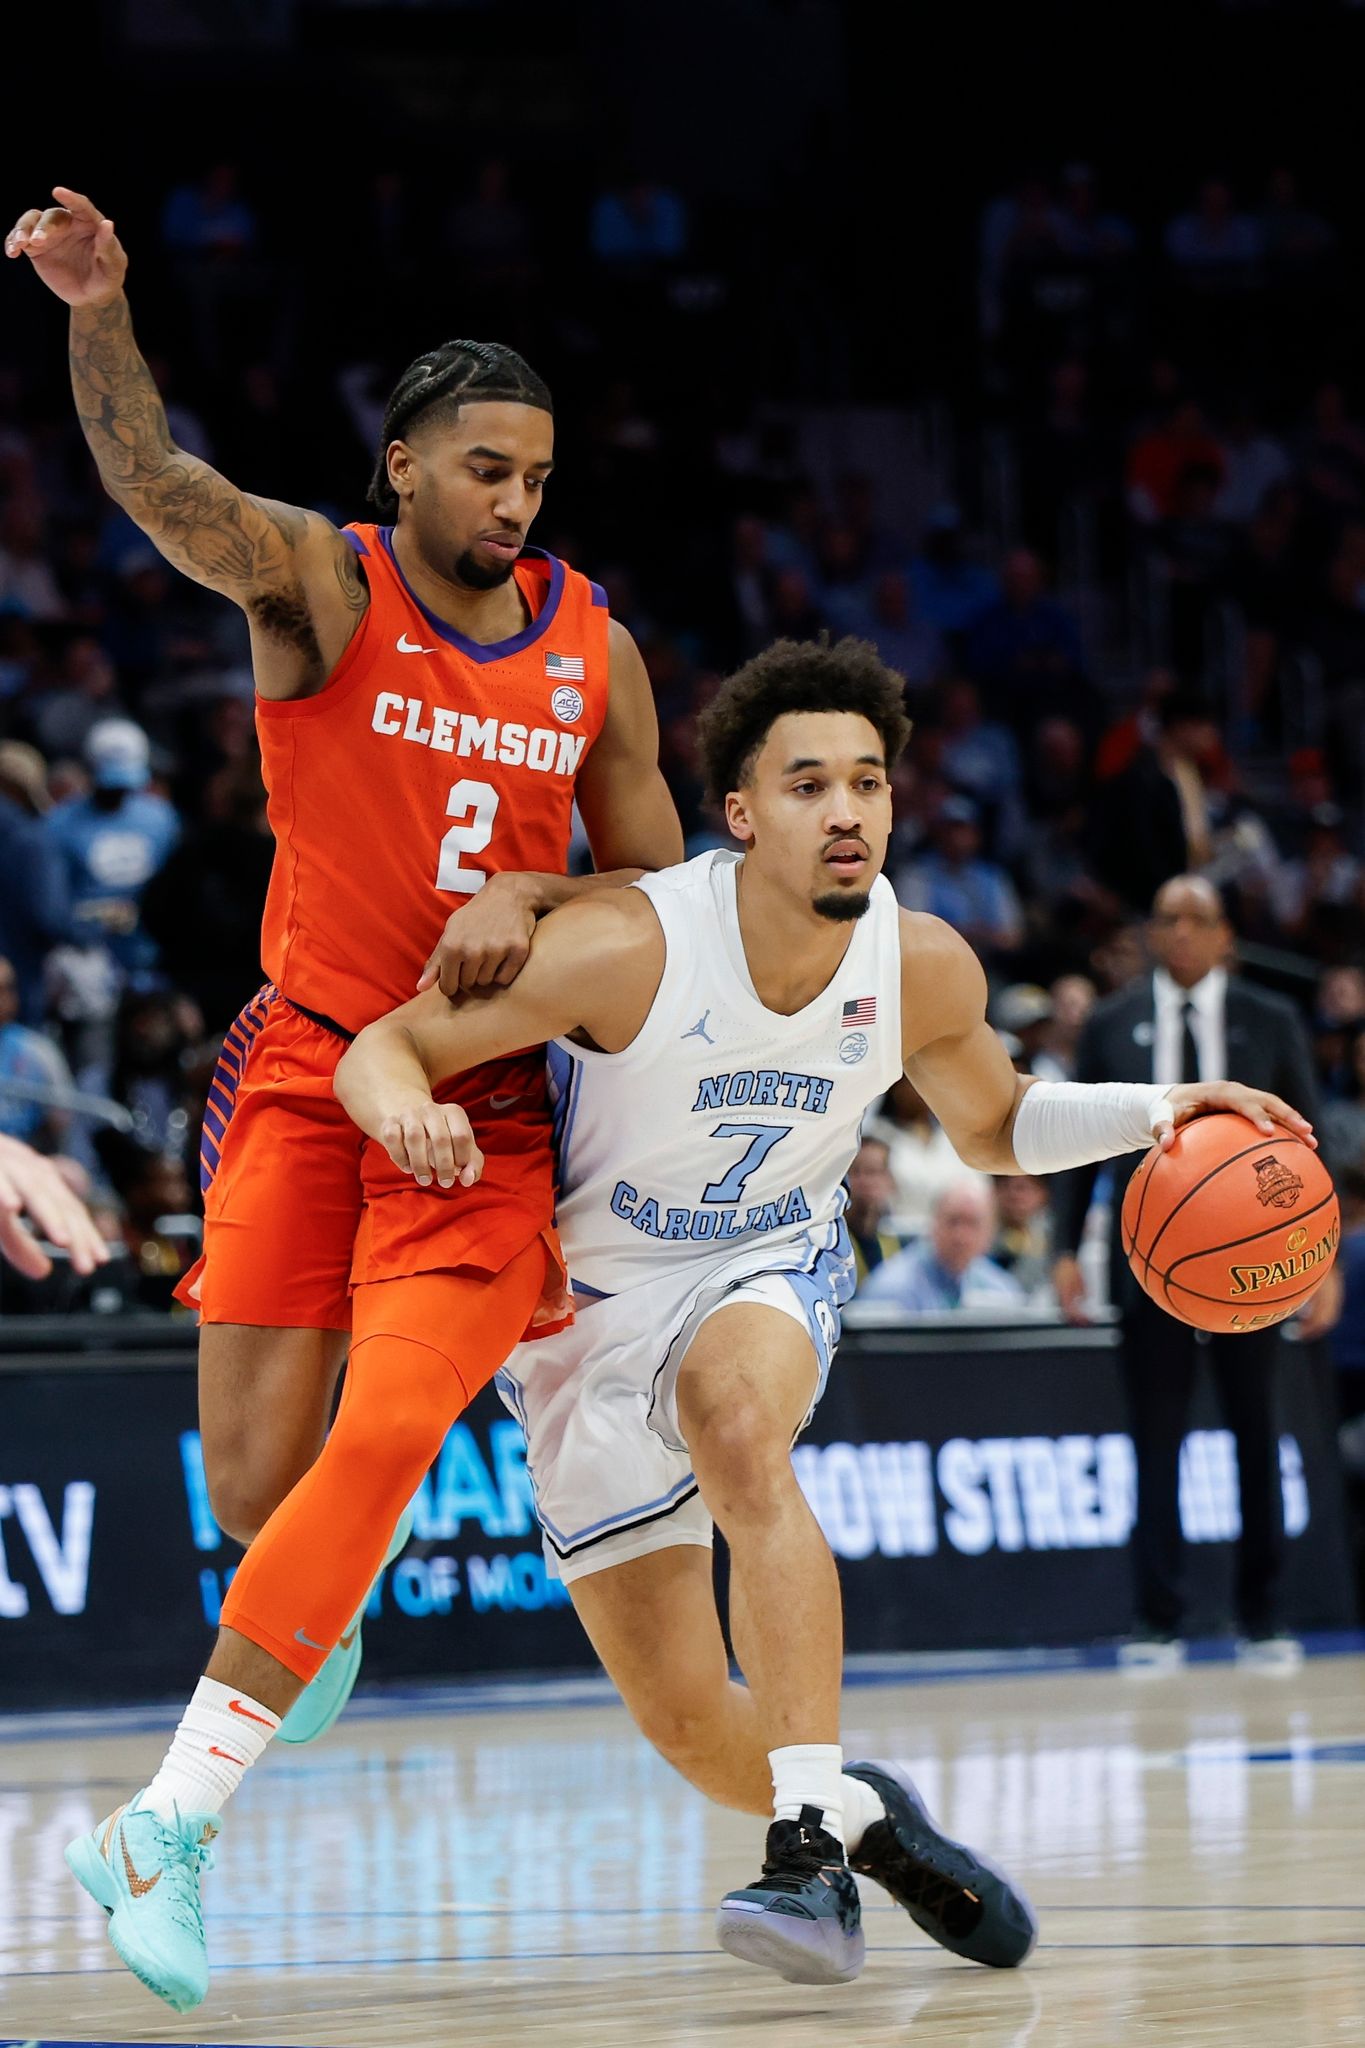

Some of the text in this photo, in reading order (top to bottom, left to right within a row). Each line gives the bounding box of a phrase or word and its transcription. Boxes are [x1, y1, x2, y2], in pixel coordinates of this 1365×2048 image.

[371, 691, 587, 776] CLEMSON
[557, 698, 579, 708] ACC
[435, 779, 499, 893] 2
[691, 1070, 834, 1114] NORTH
[700, 1123, 794, 1203] 7
[610, 1180, 811, 1241] CAROLINA
[1229, 1216, 1338, 1296] SPALDING
[393, 1556, 461, 1617] OF
